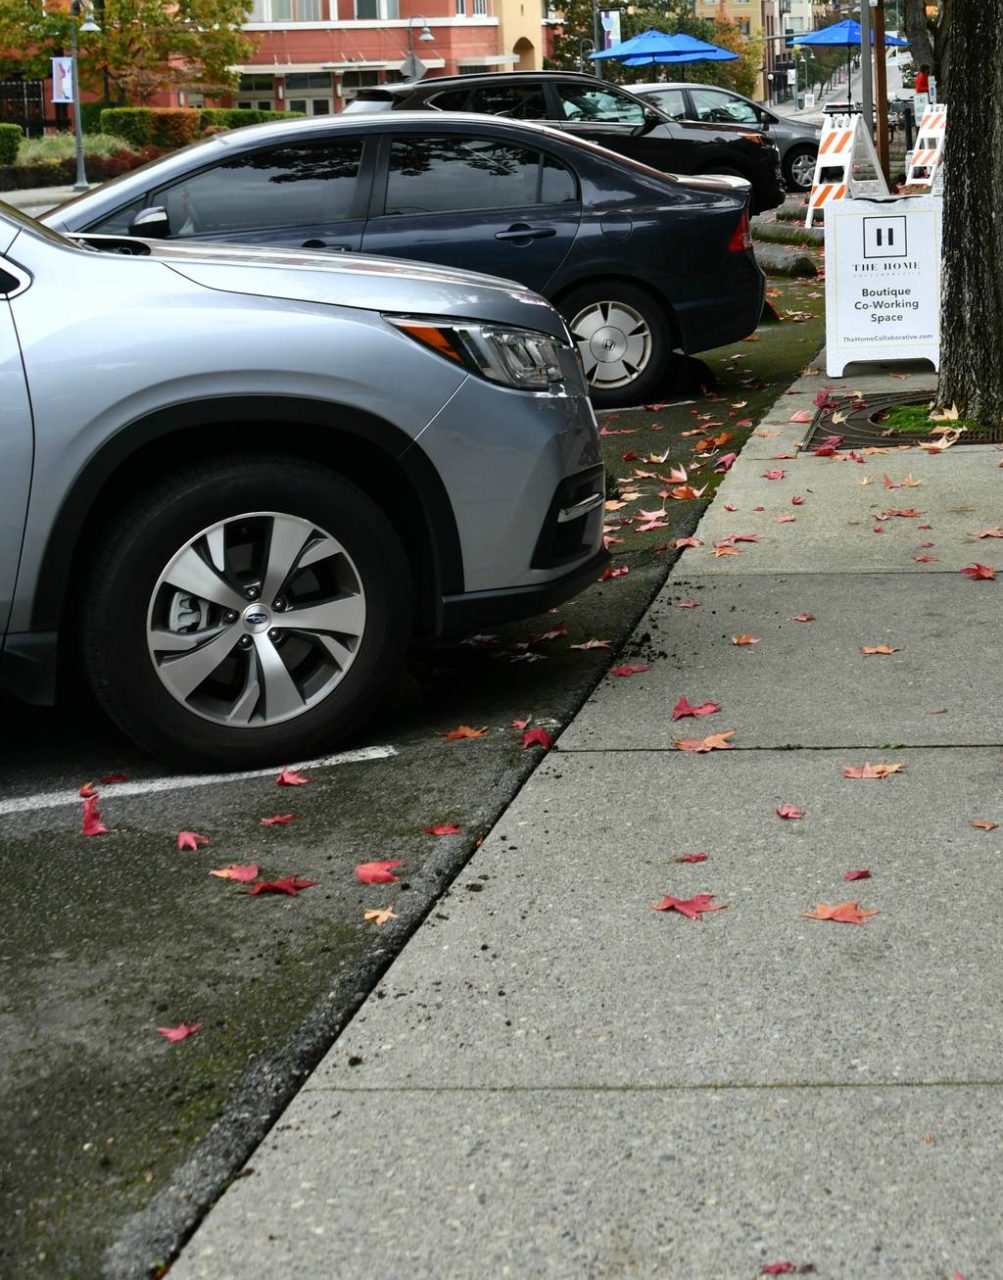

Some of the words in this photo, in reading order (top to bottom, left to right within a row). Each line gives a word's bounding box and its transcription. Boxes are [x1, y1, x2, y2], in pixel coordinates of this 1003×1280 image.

[851, 263, 878, 271] THE
[884, 262, 920, 271] HOME
[862, 287, 911, 298] Boutique
[854, 299, 919, 310] Co-Working
[871, 313, 903, 324] Space
[843, 333, 934, 343] TheHomeCollaborative.com
